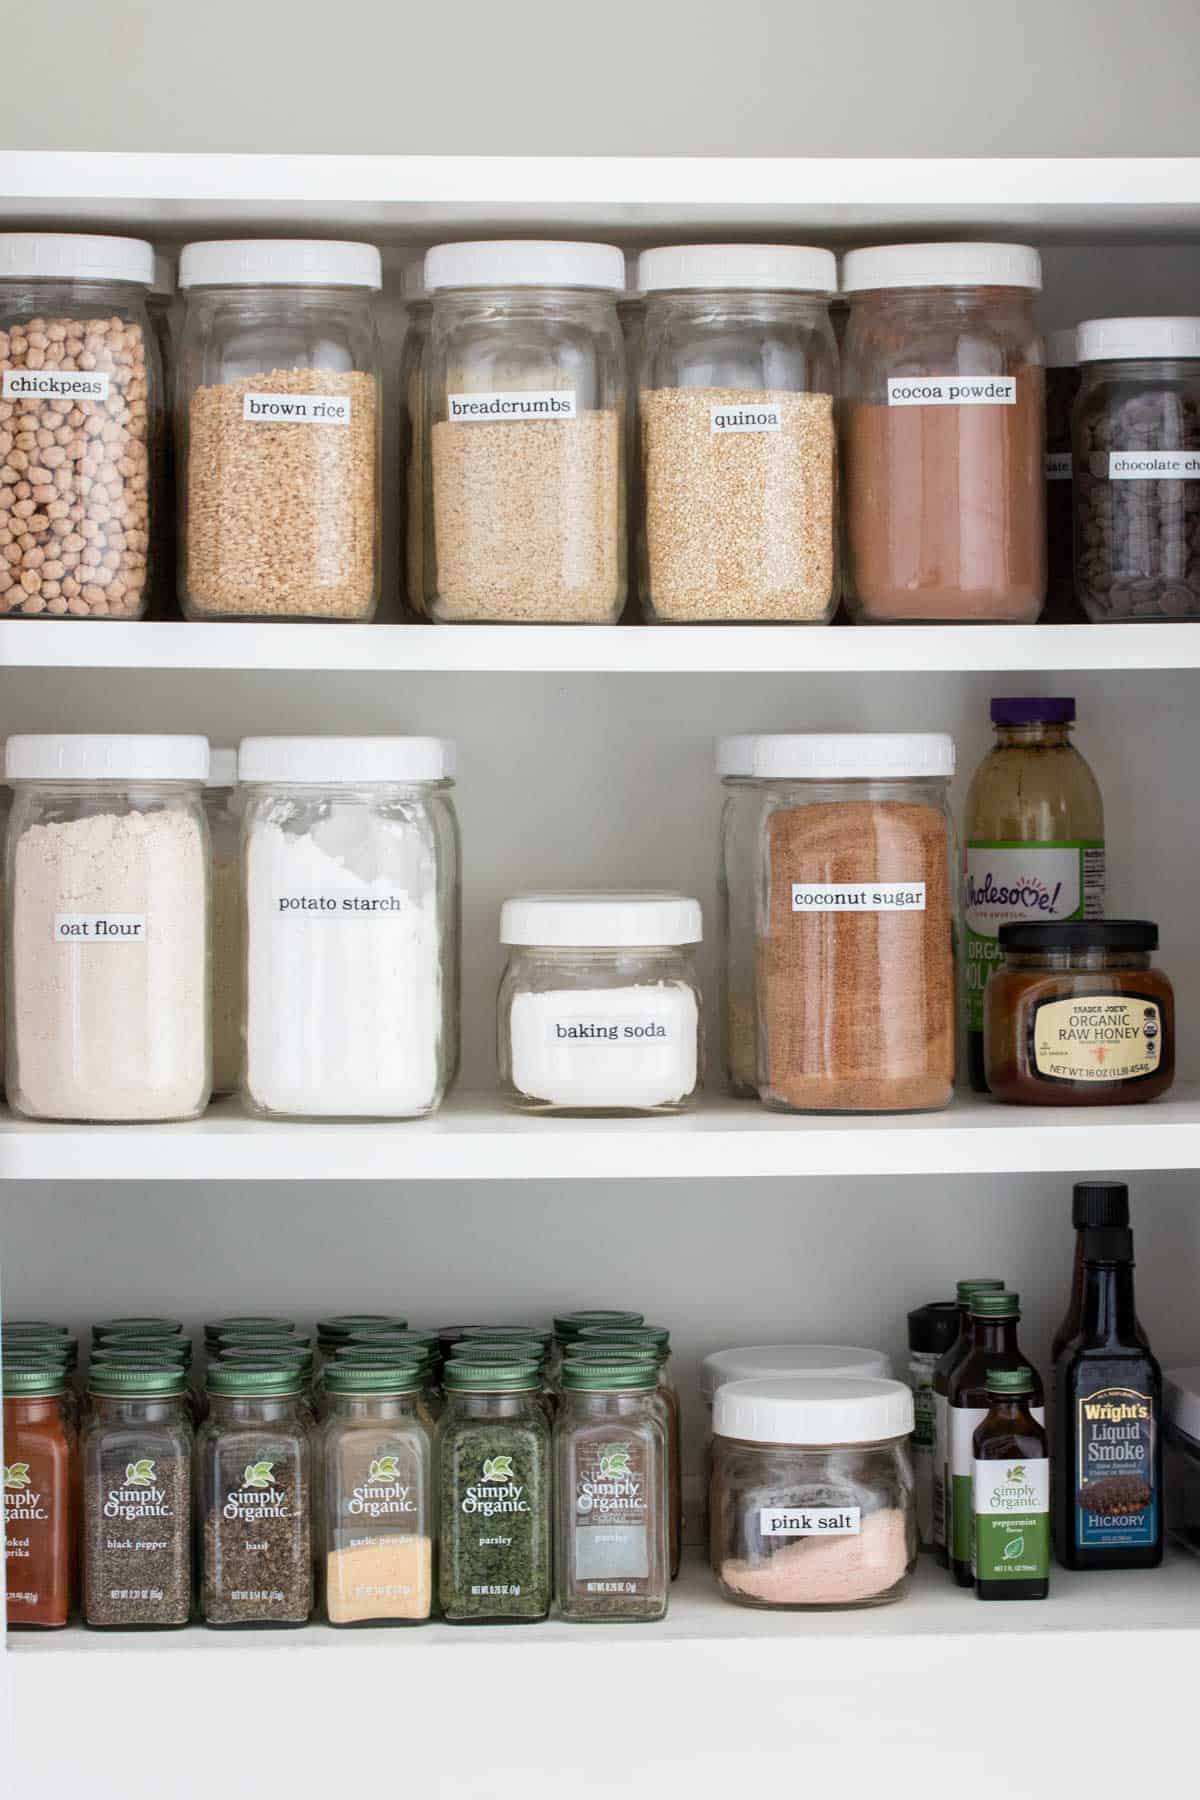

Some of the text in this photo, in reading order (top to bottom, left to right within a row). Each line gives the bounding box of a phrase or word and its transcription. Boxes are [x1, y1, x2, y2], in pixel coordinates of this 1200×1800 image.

[10, 377, 102, 394] chickpeas
[892, 383, 1012, 400] cocoa powder
[250, 399, 345, 417] brown rice
[451, 398, 571, 415] breadcrumbs
[714, 411, 778, 428] quinoa
[1114, 459, 1200, 471] chocolate ch
[279, 896, 401, 911] potato starch
[795, 891, 923, 907] coconut sugar
[60, 921, 141, 936] oat flour
[1069, 1014, 1130, 1027] ORGANIC
[556, 1023, 666, 1040] baking soda
[1059, 1027, 1139, 1041] RAW HONEY
[1050, 1064, 1068, 1074] NET
[1068, 1066, 1083, 1076] WT
[1095, 1068, 1108, 1077] OZ
[1086, 1404, 1147, 1421] Wright's
[1092, 1423, 1140, 1443] Liquid
[1088, 1443, 1145, 1462] Smoke
[109, 1487, 165, 1505] Simply
[353, 1483, 408, 1501] Simply
[466, 1483, 523, 1501] Simply
[583, 1480, 639, 1497] Simply
[993, 1485, 1036, 1500] Simply
[5, 1489, 40, 1508] mply
[228, 1488, 284, 1507] Simply
[771, 1514, 852, 1531] pink salt
[1088, 1515, 1144, 1527] HICKORY
[107, 1539, 168, 1551] black pepper
[246, 1541, 268, 1550] basil
[480, 1536, 513, 1547] parsley
